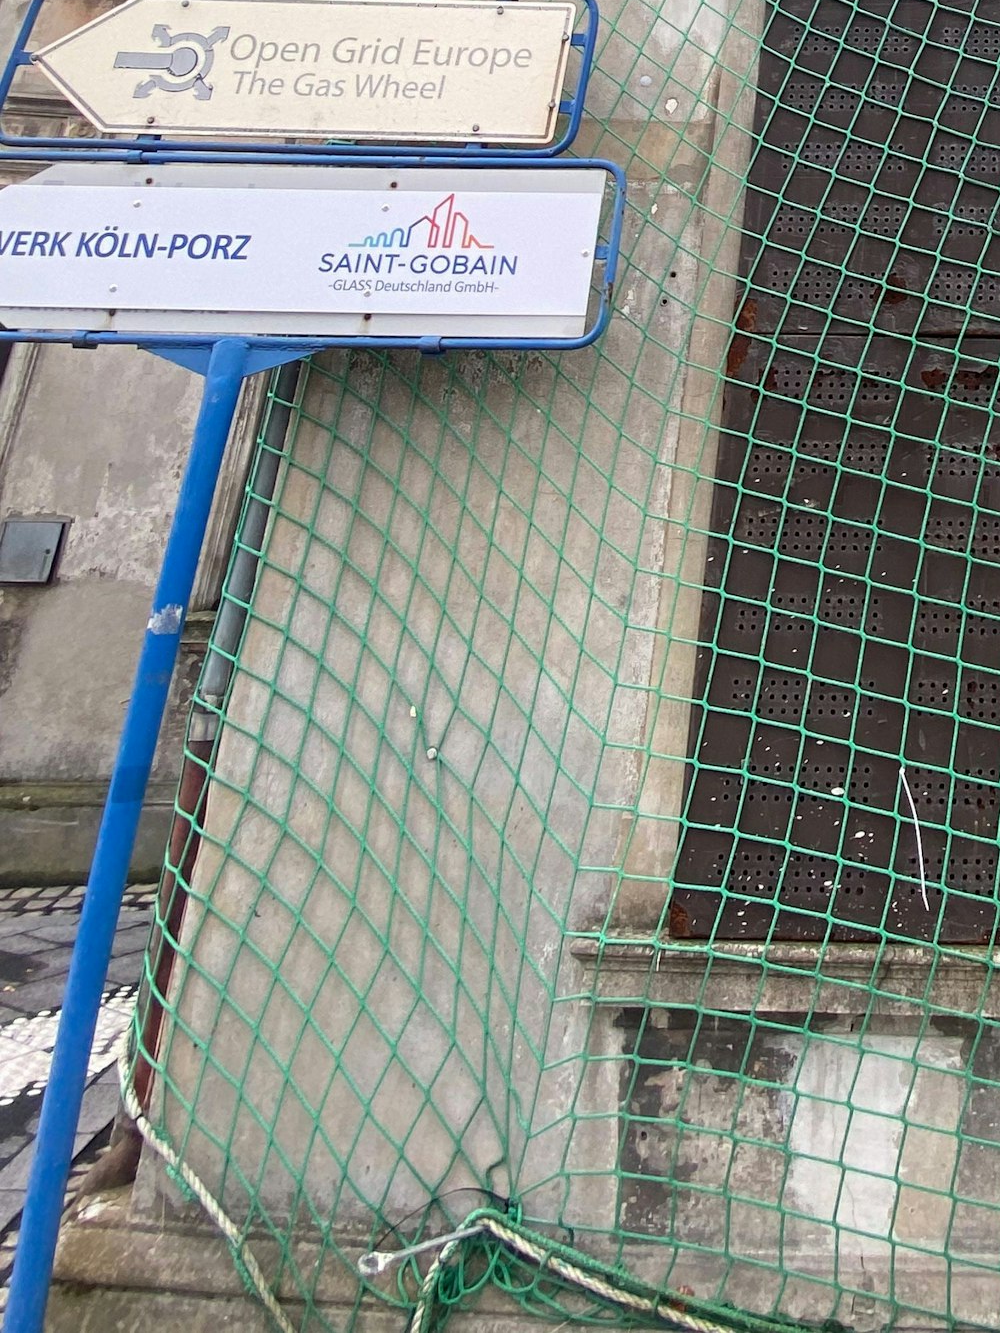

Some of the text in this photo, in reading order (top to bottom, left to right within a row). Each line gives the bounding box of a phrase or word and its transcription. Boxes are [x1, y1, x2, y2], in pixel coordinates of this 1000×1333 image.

[229, 33, 533, 75] Open Grid Europe
[233, 69, 447, 100] The Gas Wheel
[75, 225, 252, 261] KÖLN-PORZ
[318, 253, 518, 276] SAINT-GOBAIN
[374, 279, 451, 294] Deutschland
